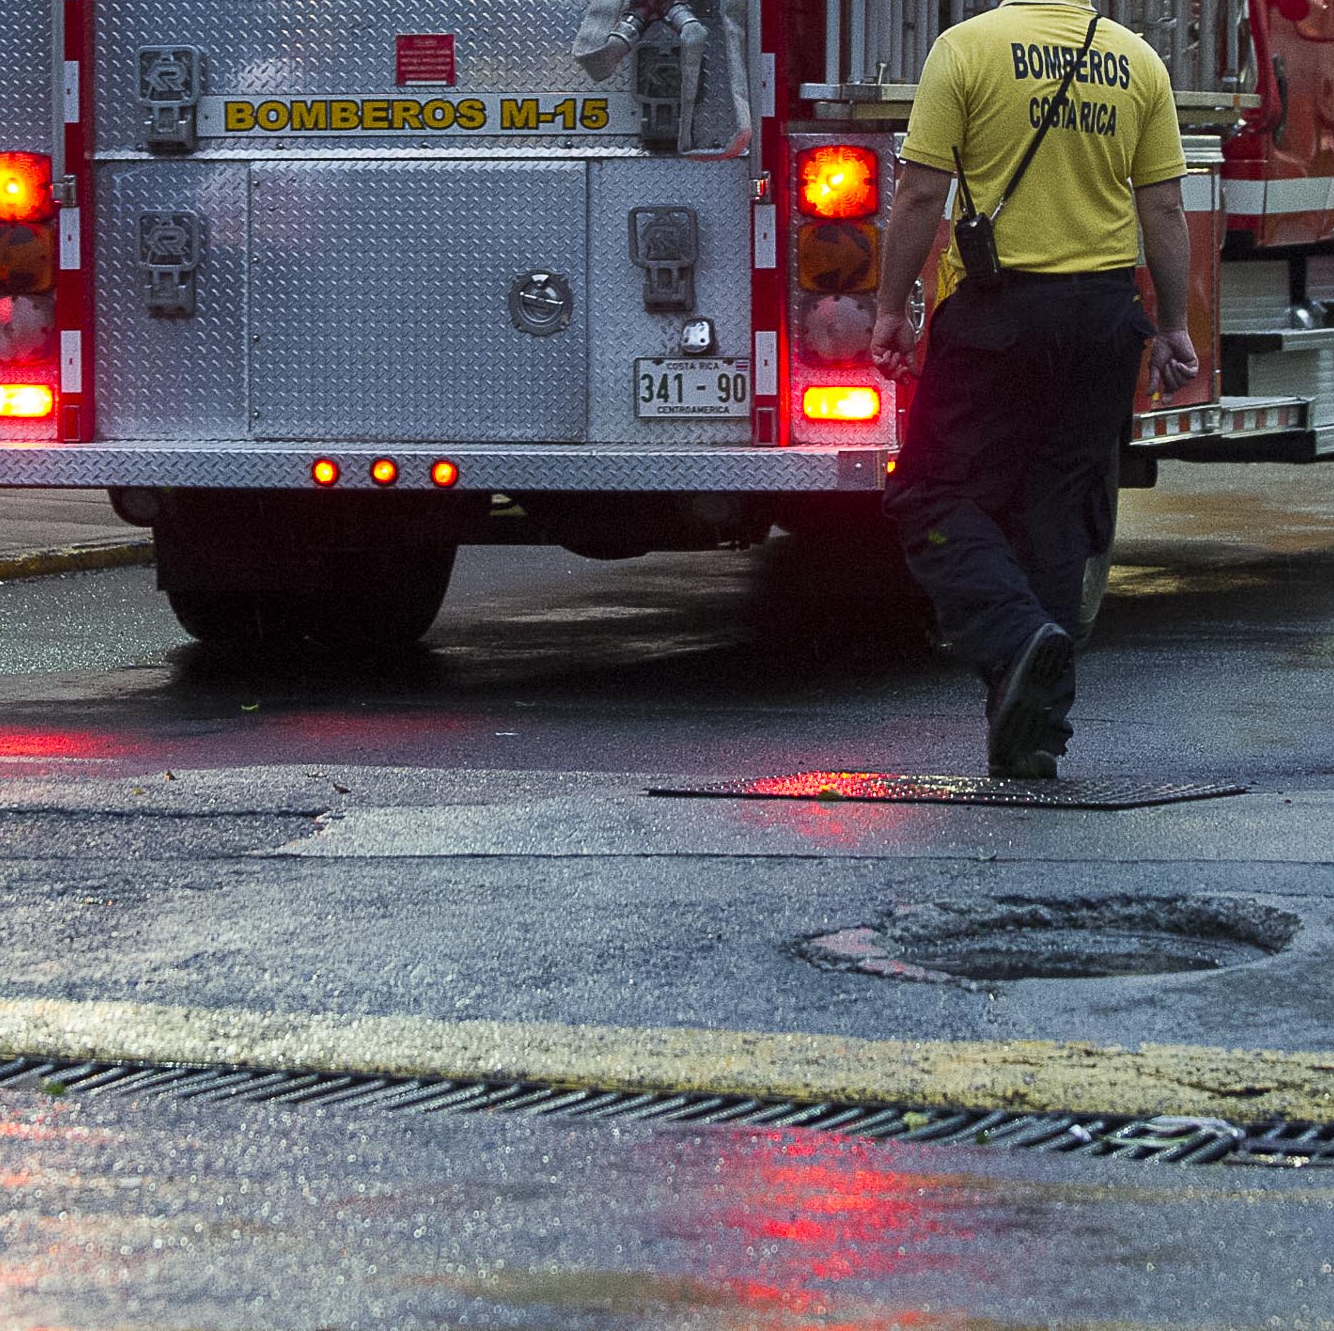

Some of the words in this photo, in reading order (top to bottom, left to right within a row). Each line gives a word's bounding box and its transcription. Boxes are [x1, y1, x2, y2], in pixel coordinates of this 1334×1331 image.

[1011, 43, 1130, 90] BOMBEROS
[224, 98, 487, 131] BOMBEROS
[500, 98, 609, 130] M-15
[1080, 101, 1116, 136] RICA
[667, 362, 695, 370] COSTA
[699, 362, 719, 370] RICA
[641, 373, 683, 403] 341
[717, 373, 746, 403] 90
[657, 406, 730, 414] CENTROAMERICA
